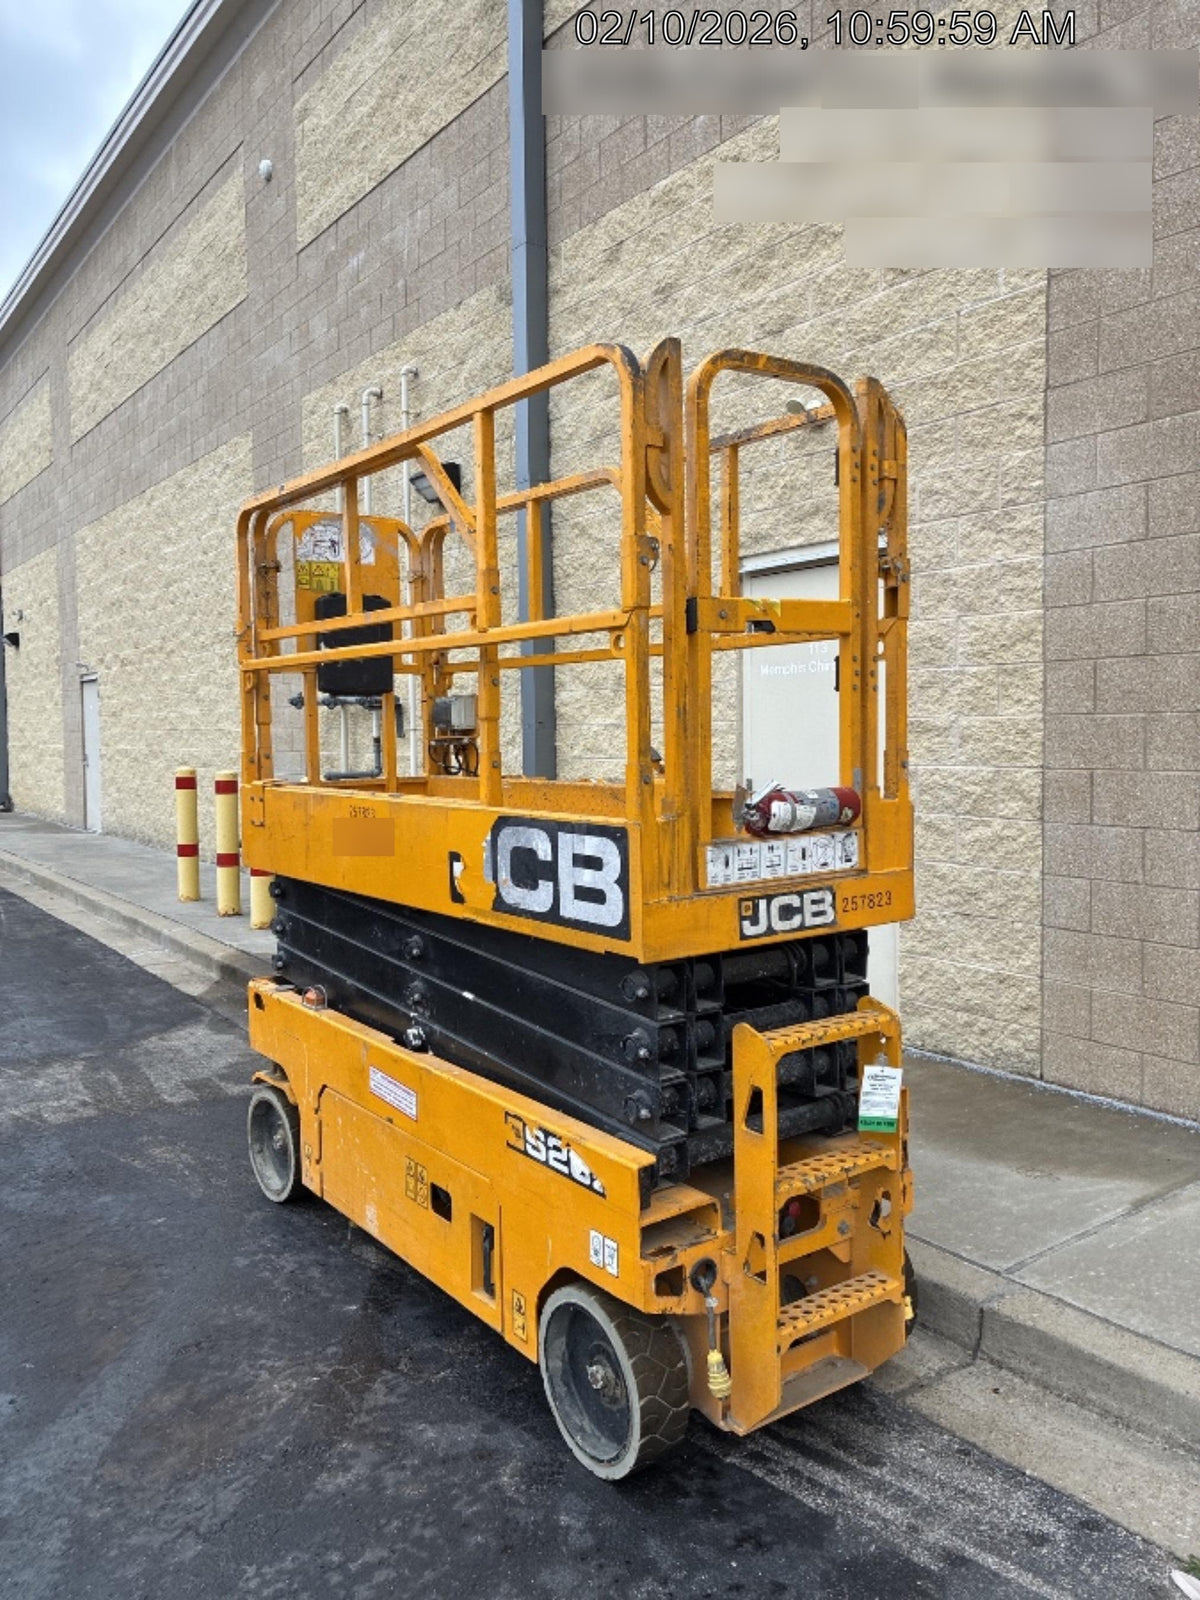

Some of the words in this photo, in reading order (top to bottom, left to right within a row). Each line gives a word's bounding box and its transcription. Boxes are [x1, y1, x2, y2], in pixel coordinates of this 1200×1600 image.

[482, 825, 624, 928] CB
[741, 889, 835, 937] JCB
[842, 890, 892, 914] 257823
